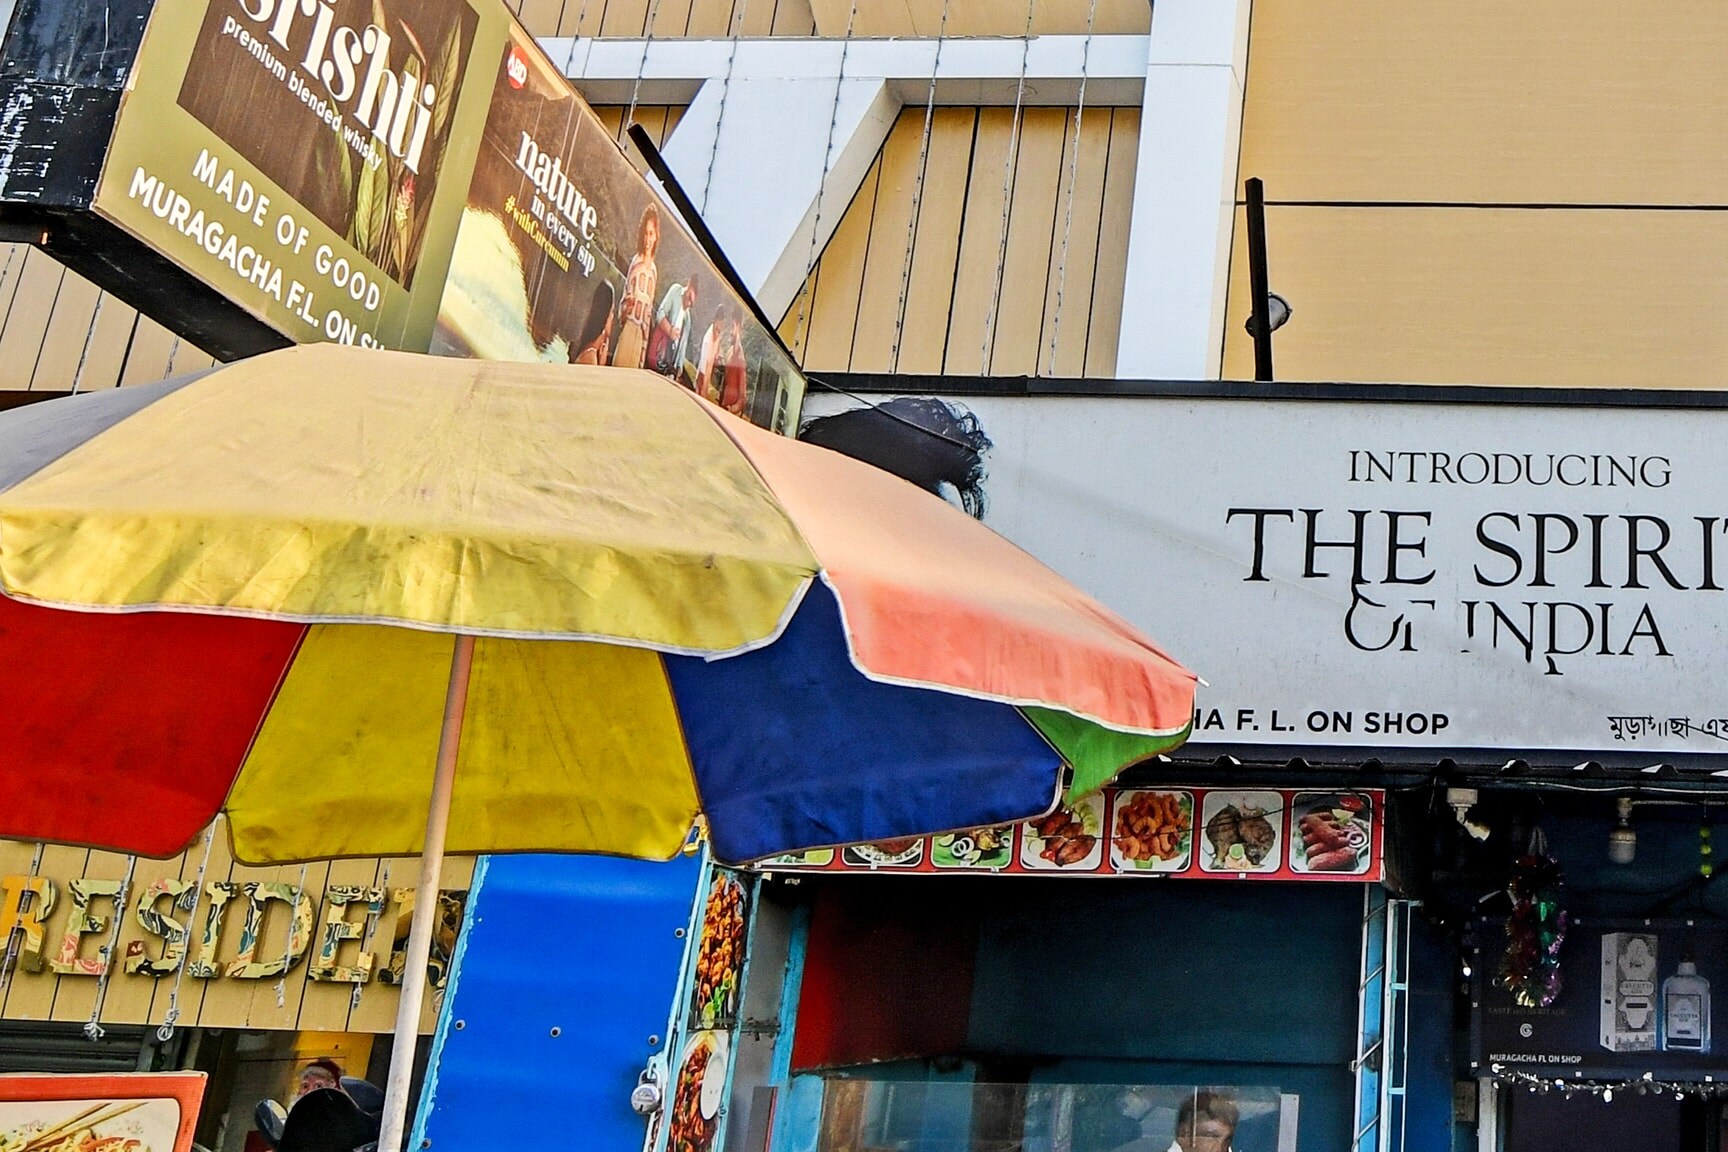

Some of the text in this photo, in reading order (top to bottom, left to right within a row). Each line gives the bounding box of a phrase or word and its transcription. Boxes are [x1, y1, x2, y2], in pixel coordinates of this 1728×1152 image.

[222, 15, 384, 171] premium blended whisky
[515, 130, 598, 241] nature
[128, 166, 286, 303] MURAGACHA
[285, 279, 320, 328] F.L.
[325, 310, 358, 346] ON
[191, 148, 381, 312] MADE OF GOOD
[530, 187, 597, 277] in every sip
[1347, 450, 1673, 488] INTRODUCING
[1225, 508, 1437, 585] THE
[1460, 600, 1675, 672] INDIA
[1306, 711, 1352, 733] ON
[1363, 711, 1450, 735] SHOP
[1489, 1053, 1538, 1062] MURAGACHA
[1548, 1054, 1560, 1063] ON
[1561, 1055, 1583, 1064] SHOP
